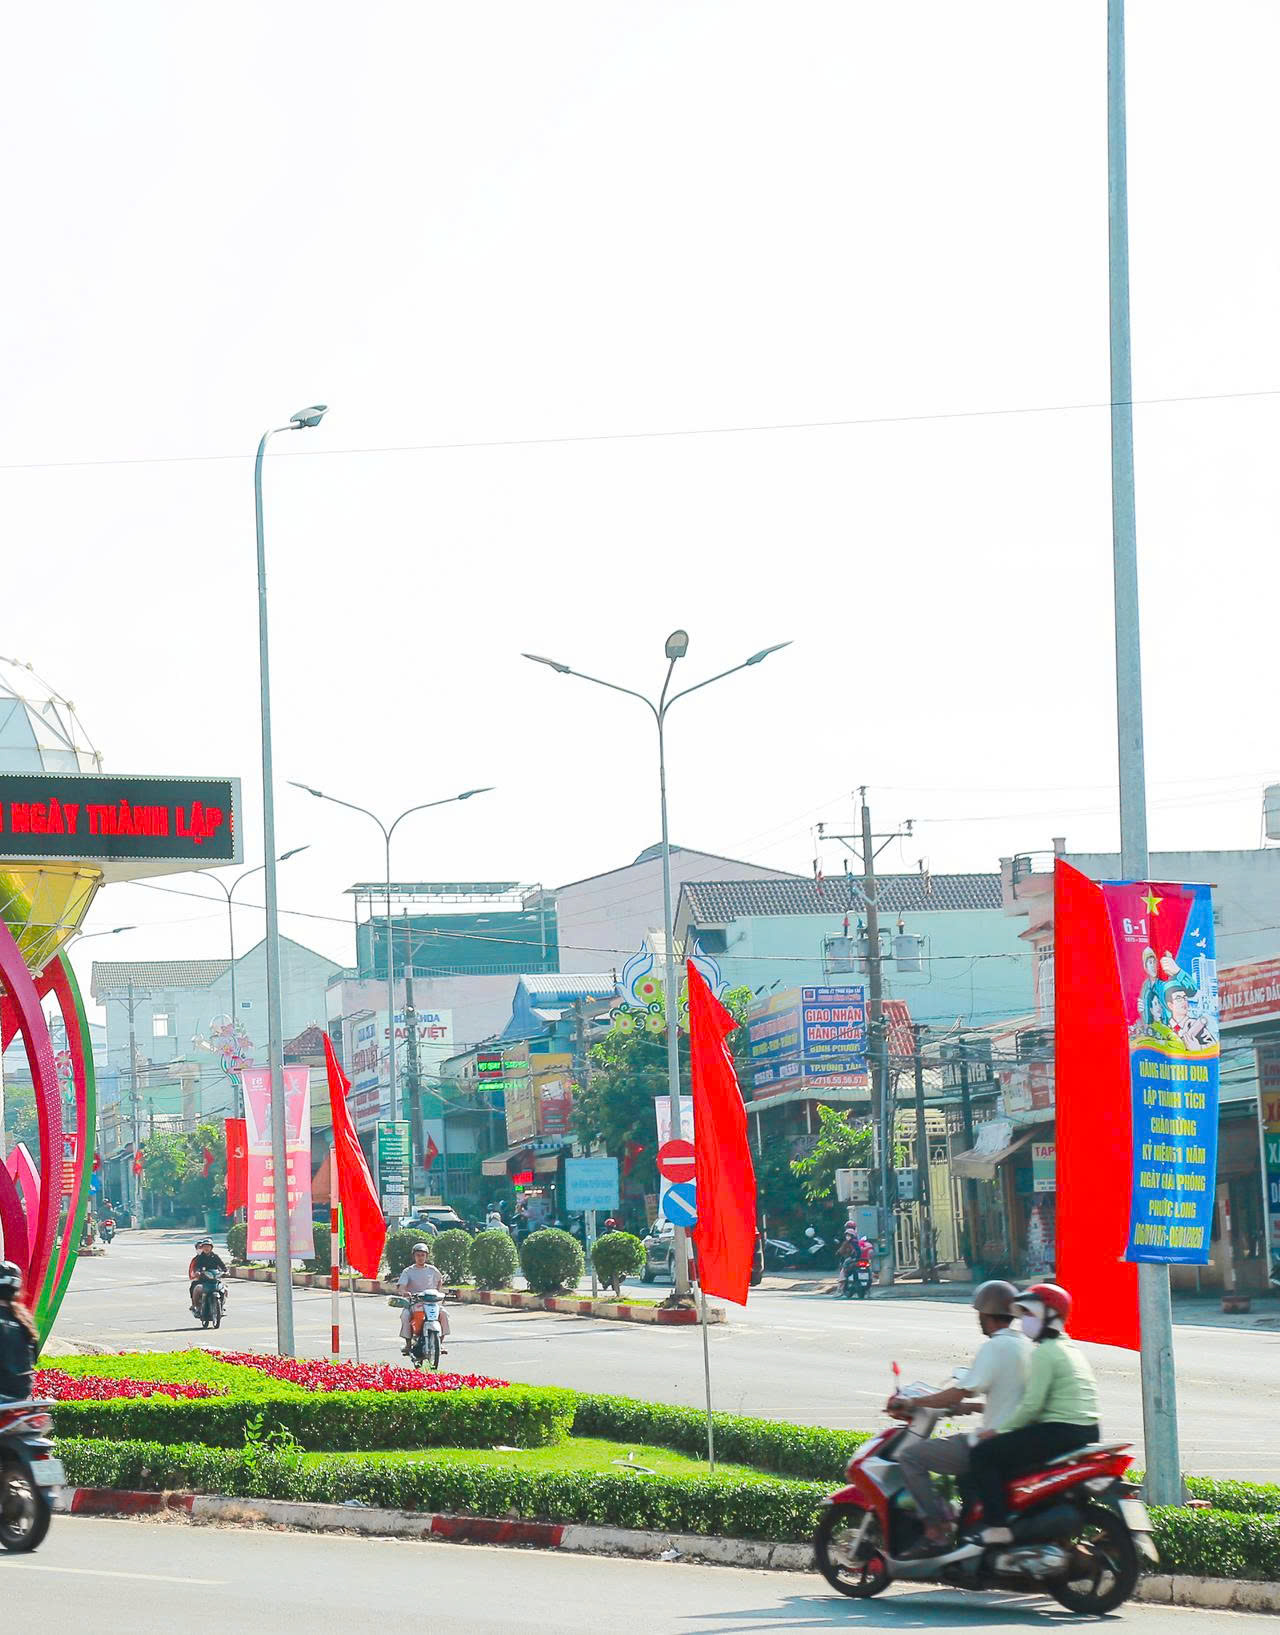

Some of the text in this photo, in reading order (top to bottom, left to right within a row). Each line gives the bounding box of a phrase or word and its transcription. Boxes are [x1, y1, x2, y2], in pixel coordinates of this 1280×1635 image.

[11, 797, 80, 834] NGÀY
[86, 799, 169, 836] THÀNH
[175, 801, 223, 844] LẬP
[1122, 917, 1147, 935] 6-1
[805, 1005, 863, 1024] GIAO NHẬN
[417, 1024, 447, 1041] VIỆT
[807, 1024, 837, 1041] HÀNG
[1190, 1065, 1209, 1082] ĐUA
[1143, 1086, 1157, 1109] LẬP
[1184, 1089, 1206, 1110] TÍCH
[1186, 1144, 1206, 1165] NĂM
[1140, 1168, 1161, 1189] NGÀY
[1175, 1171, 1206, 1192] PHÓNG
[1174, 1202, 1197, 1219] LONG
